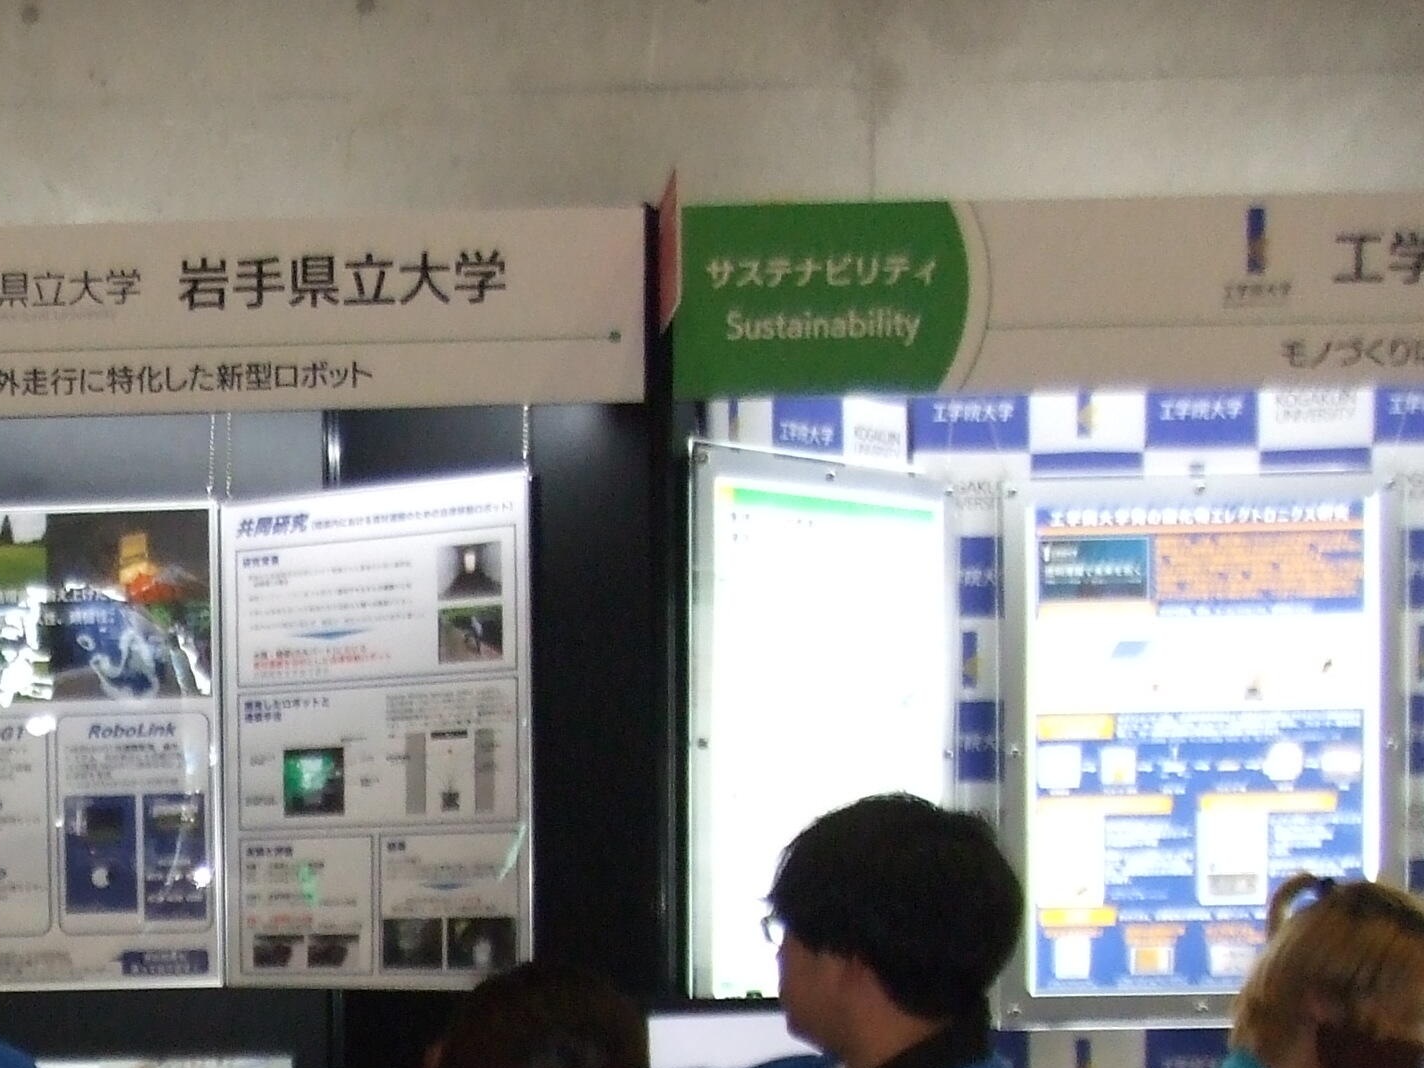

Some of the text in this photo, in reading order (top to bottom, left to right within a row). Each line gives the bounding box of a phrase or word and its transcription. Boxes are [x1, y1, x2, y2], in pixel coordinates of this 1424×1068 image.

[179, 250, 506, 311] 岩手県立大学
[706, 256, 936, 290] サステナビリティ
[725, 307, 921, 346] Sustainability
[88, 721, 178, 740] RoboLink
